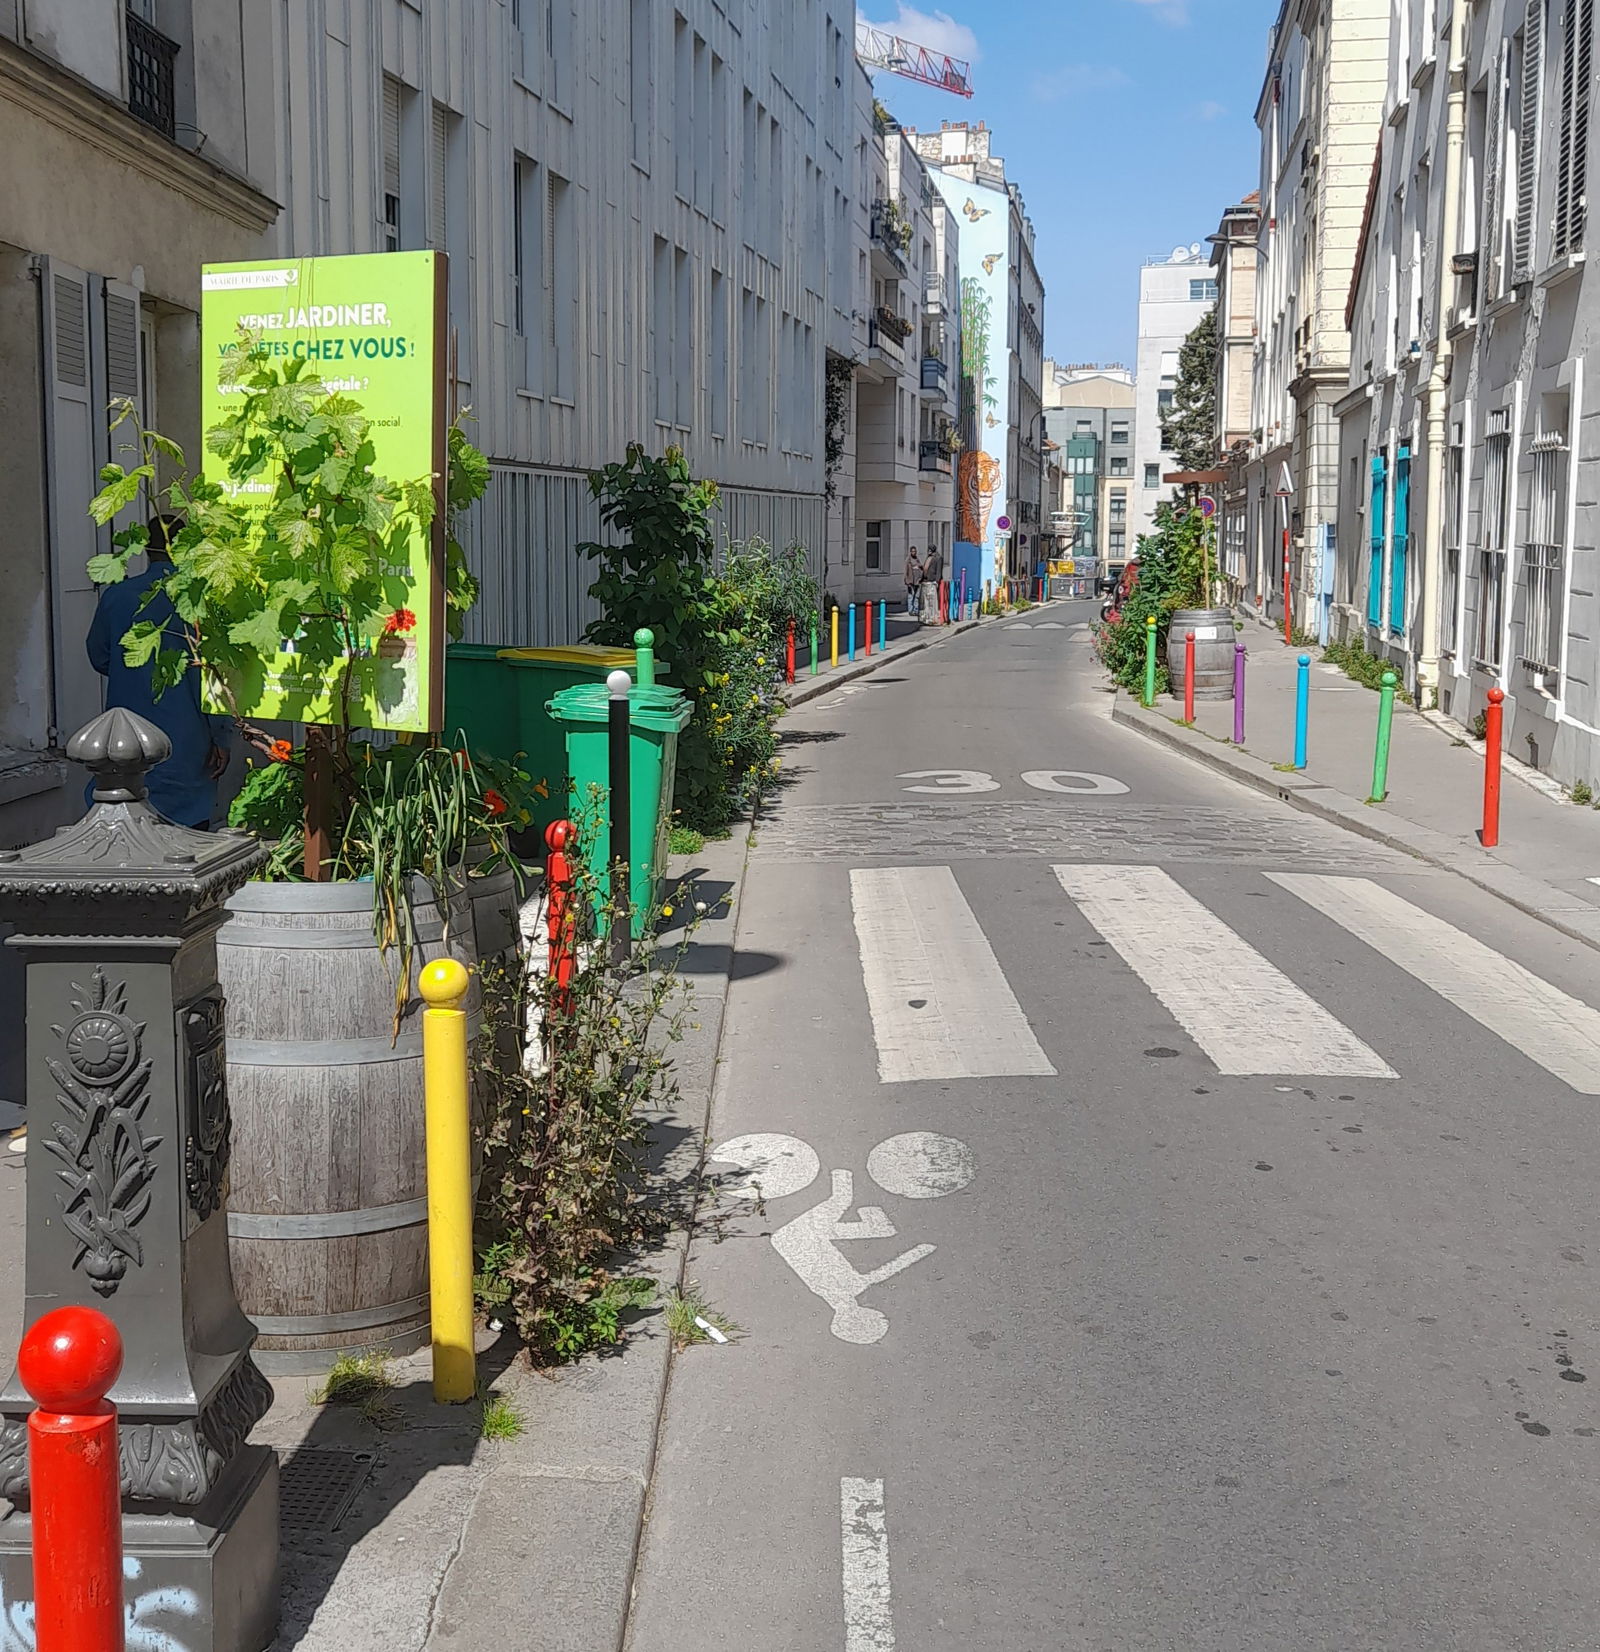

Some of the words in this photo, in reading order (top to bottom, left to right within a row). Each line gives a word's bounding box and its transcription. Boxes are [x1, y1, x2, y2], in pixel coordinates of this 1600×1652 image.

[210, 276, 240, 286] MAIRIE
[241, 275, 254, 284] DE
[255, 273, 280, 284] PARIS
[239, 313, 284, 330] VENEZ
[286, 303, 392, 329] JARDINER,
[292, 338, 345, 360] CHEZ
[350, 337, 407, 358] VOUS
[410, 342, 416, 357] !
[377, 416, 401, 427] social
[378, 558, 413, 577] Paris
[894, 769, 1131, 795] 30
